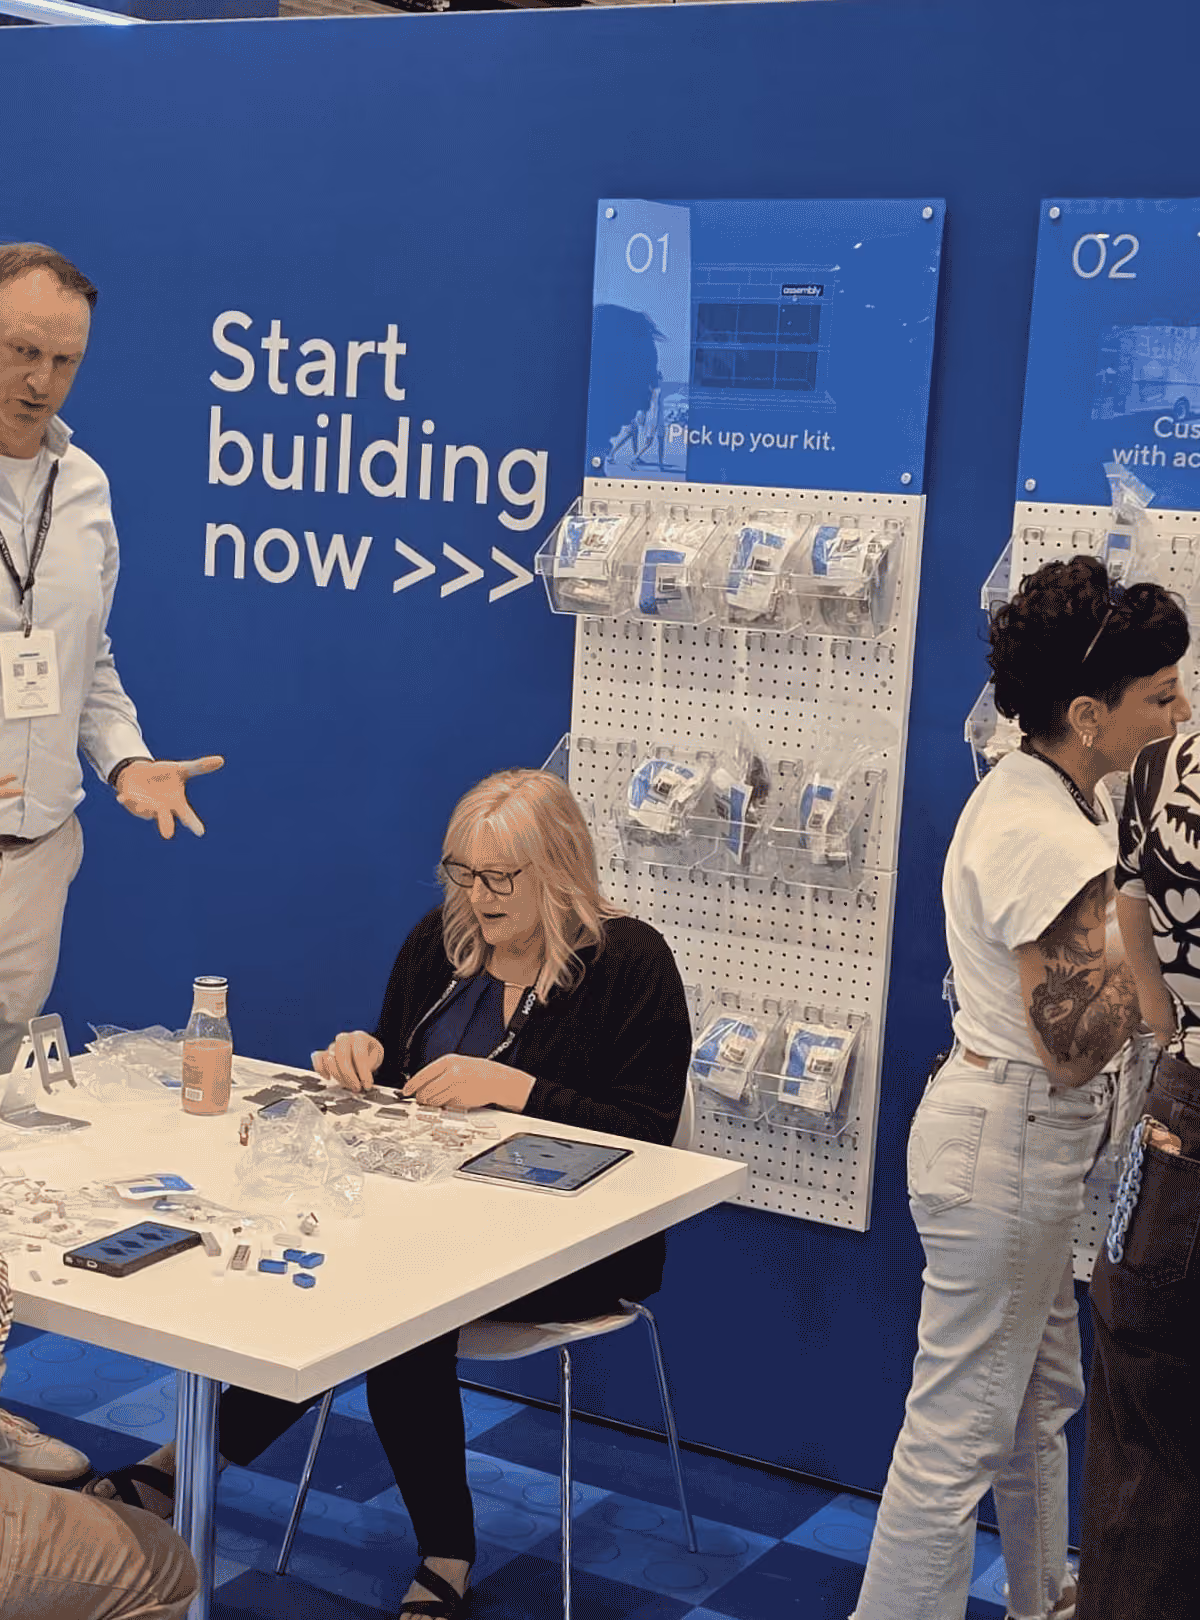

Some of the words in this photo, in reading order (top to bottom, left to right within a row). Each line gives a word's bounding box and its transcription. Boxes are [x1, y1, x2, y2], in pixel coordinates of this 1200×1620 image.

[626, 233, 669, 273] 01
[1072, 233, 1140, 279] 02
[783, 286, 822, 296] assembly
[209, 310, 406, 401] Start
[667, 423, 713, 446] Pick
[718, 432, 745, 452] up
[750, 432, 799, 453] your
[804, 429, 837, 452] kit.
[1113, 444, 1166, 467] with
[208, 405, 548, 531] building
[204, 523, 373, 590] now
